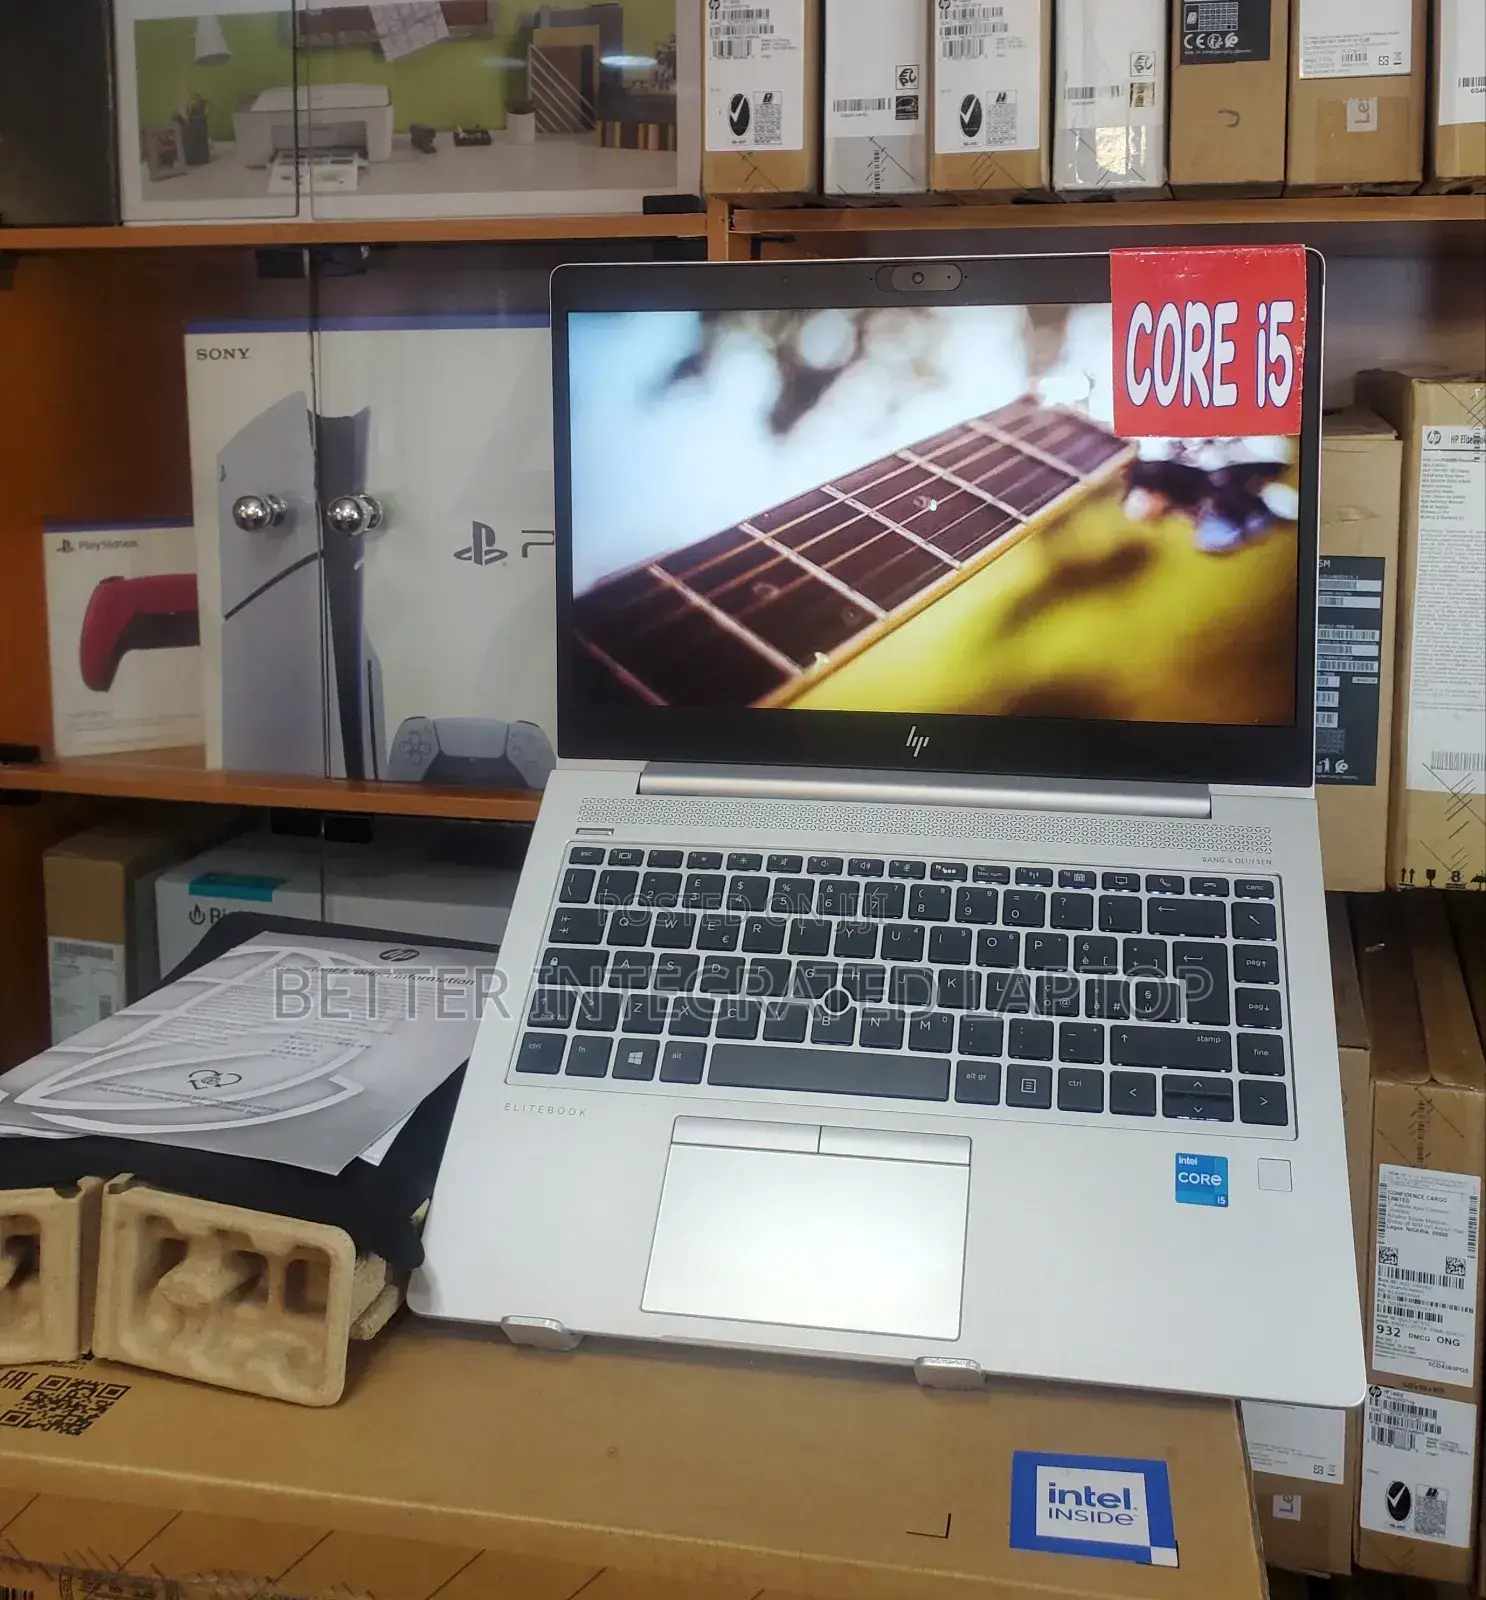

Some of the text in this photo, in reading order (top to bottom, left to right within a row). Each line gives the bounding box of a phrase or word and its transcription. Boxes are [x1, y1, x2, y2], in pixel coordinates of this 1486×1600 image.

[1354, 97, 1370, 124] Le
[196, 348, 250, 361] SONY
[1123, 300, 1295, 408] CORE i5
[1202, 856, 1225, 864] BANG
[1235, 858, 1272, 866] OLUFSEN
[917, 905, 925, 913] 8
[964, 907, 972, 916] 9
[619, 917, 629, 926] Q
[664, 920, 678, 929] W
[708, 922, 717, 931] E
[753, 924, 762, 933] R
[799, 926, 807, 935] T
[846, 929, 854, 938] Y
[892, 931, 901, 940] U
[1034, 941, 1043, 950] P
[620, 959, 630, 968] A
[666, 961, 674, 970] S
[805, 968, 814, 978] G
[851, 971, 860, 980] H
[947, 978, 957, 987] K
[634, 1003, 643, 1013] Z
[680, 1006, 689, 1016] X
[727, 1009, 737, 1018] C
[822, 1016, 830, 1026] B
[870, 1017, 880, 1027] N
[920, 1021, 931, 1030] M
[1197, 1035, 1221, 1043] stamp
[528, 1042, 541, 1050] ctrl
[1253, 1048, 1269, 1056] fine
[1068, 1079, 1082, 1087] ctrl
[504, 1102, 587, 1116] ELITEBOOK
[1178, 1156, 1198, 1165] intel
[1388, 1190, 1424, 1200] CONFIDENCE
[1217, 1196, 1226, 1204] i5
[1376, 1324, 1401, 1338] 932
[1408, 1332, 1431, 1342] DMCQ
[1437, 1336, 1460, 1347] ONG
[1048, 1481, 1132, 1510] intel
